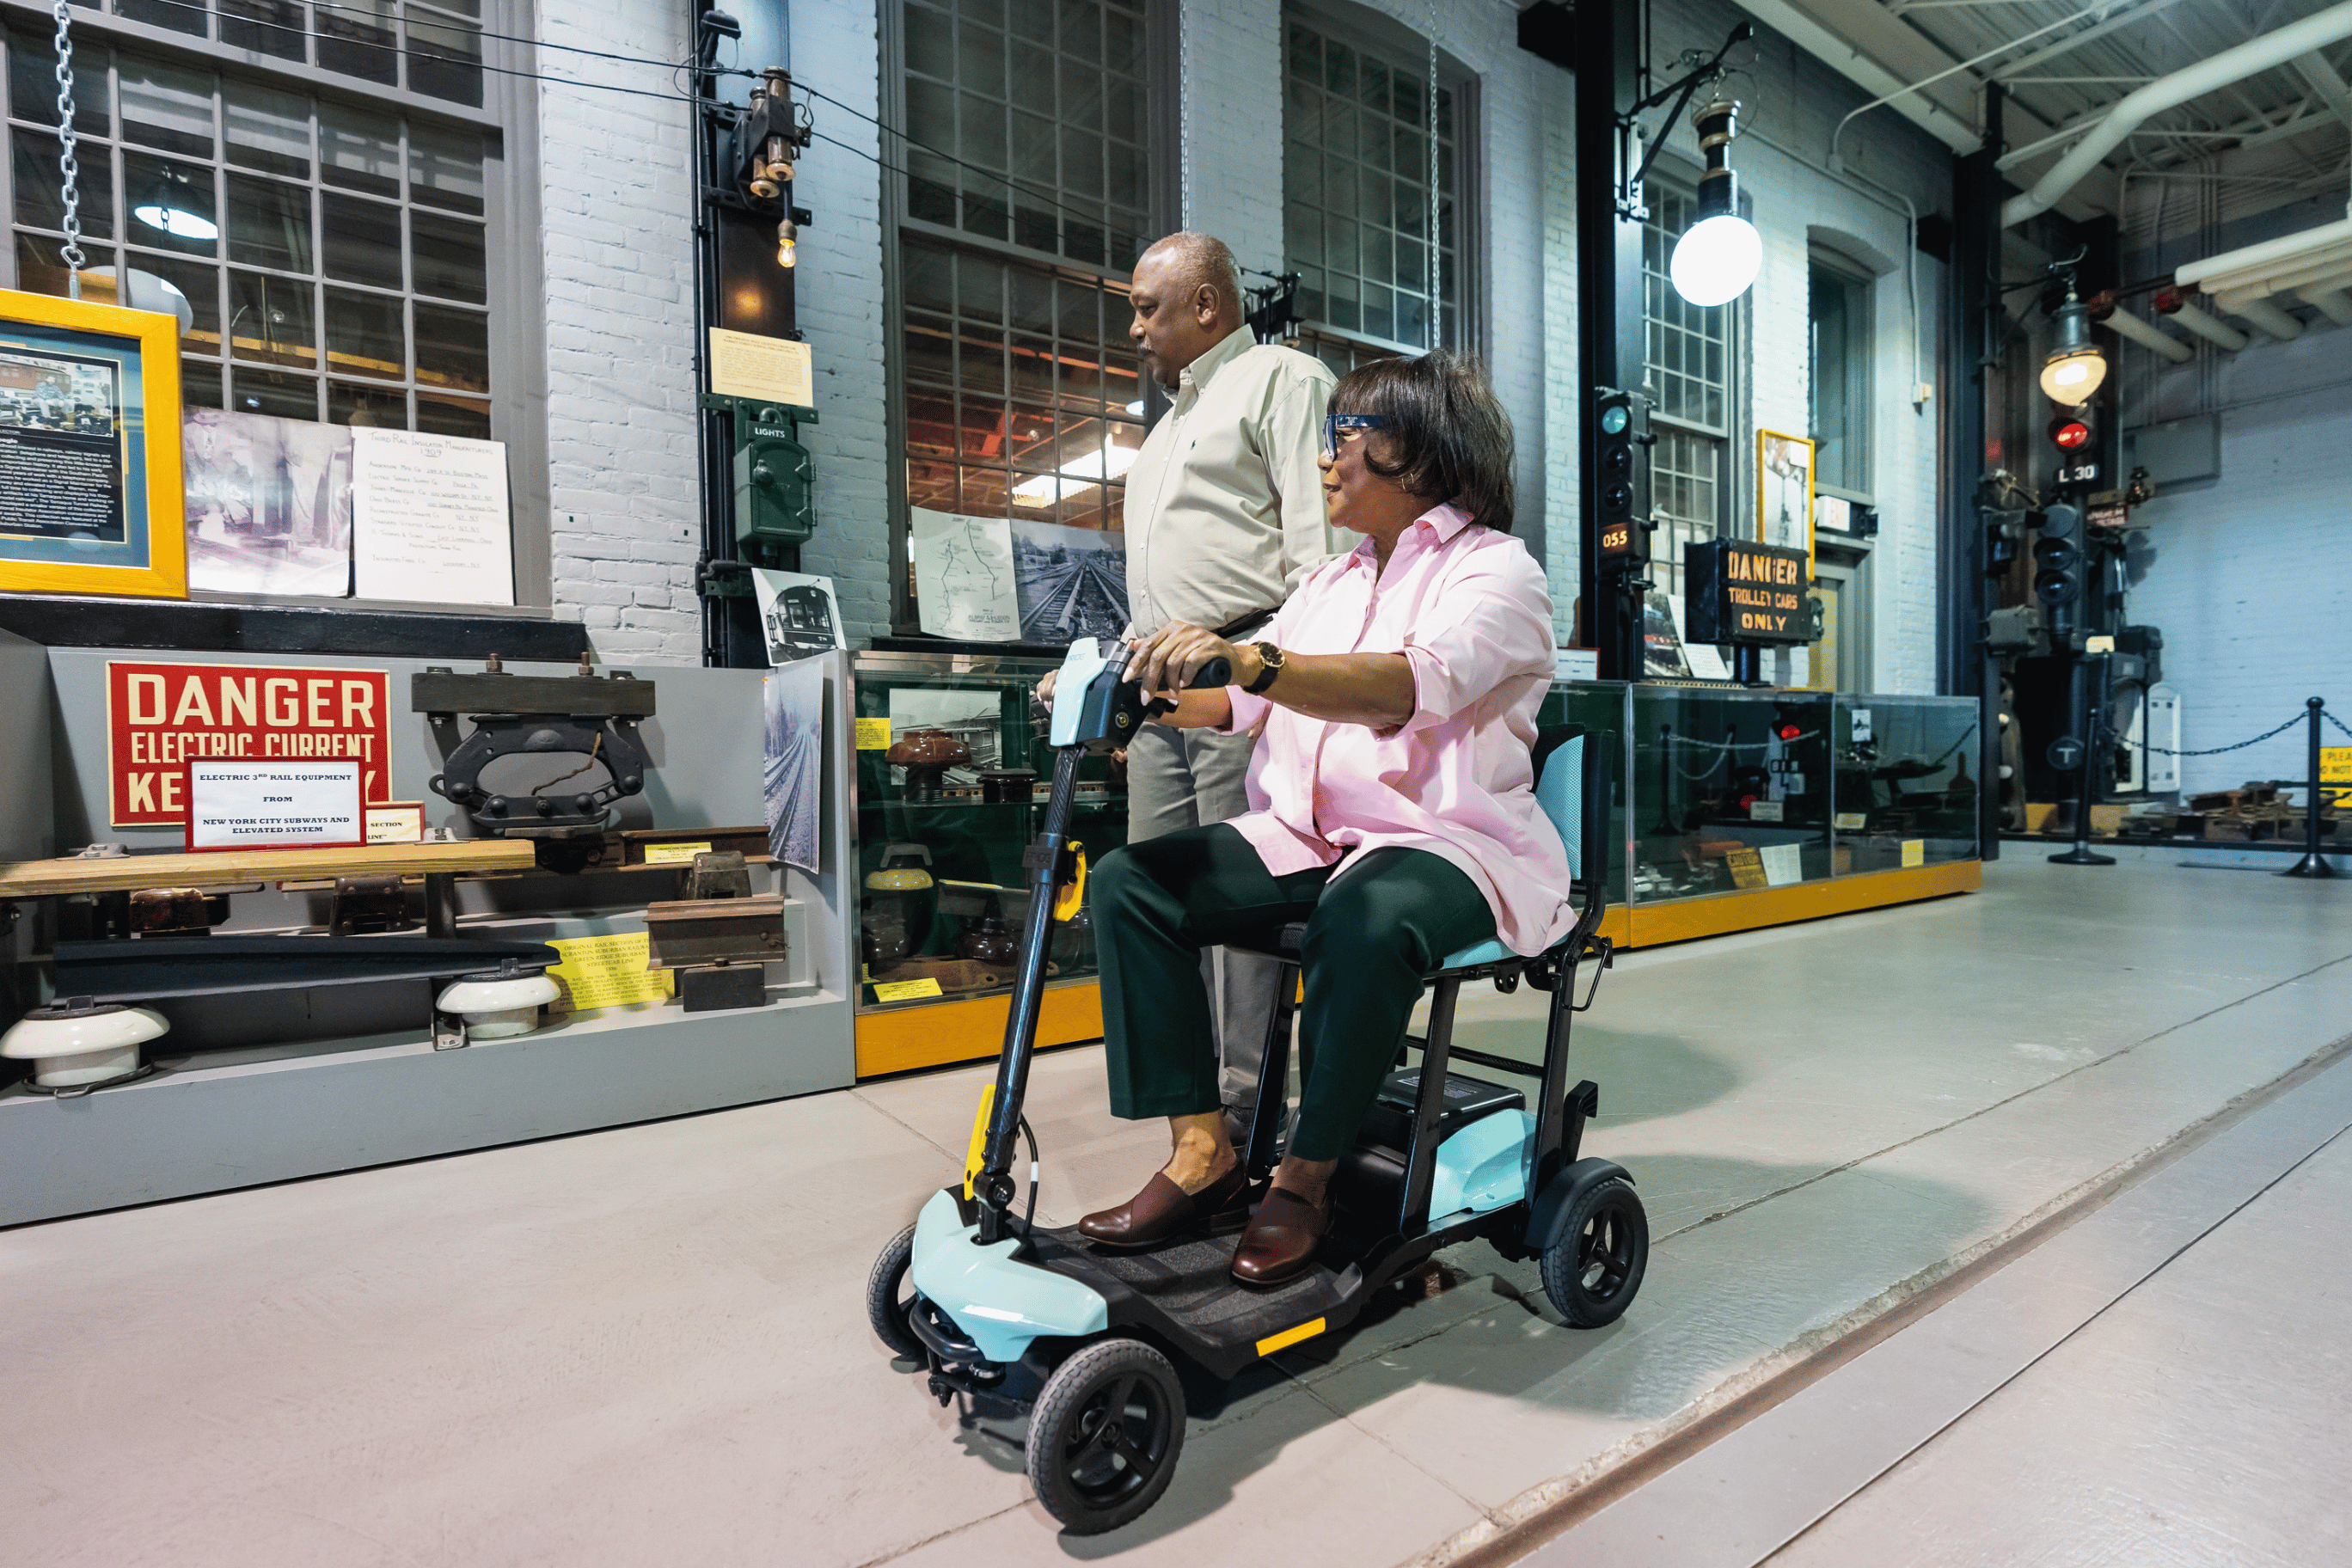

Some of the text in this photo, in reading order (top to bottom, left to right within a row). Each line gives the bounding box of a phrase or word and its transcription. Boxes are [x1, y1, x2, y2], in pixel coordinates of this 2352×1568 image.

[755, 427, 786, 438] LIGHTS
[421, 447, 442, 456] 1909
[2059, 465, 2095, 483] L 30
[1728, 551, 1798, 585] DANGER
[1728, 587, 1798, 610] TROLLEY CARS
[1742, 613, 1786, 631] ONLY
[127, 673, 375, 727] DANGER
[131, 732, 375, 763] ELECTRIC CURRENT
[2056, 748, 2077, 764] T
[129, 772, 184, 813] KE
